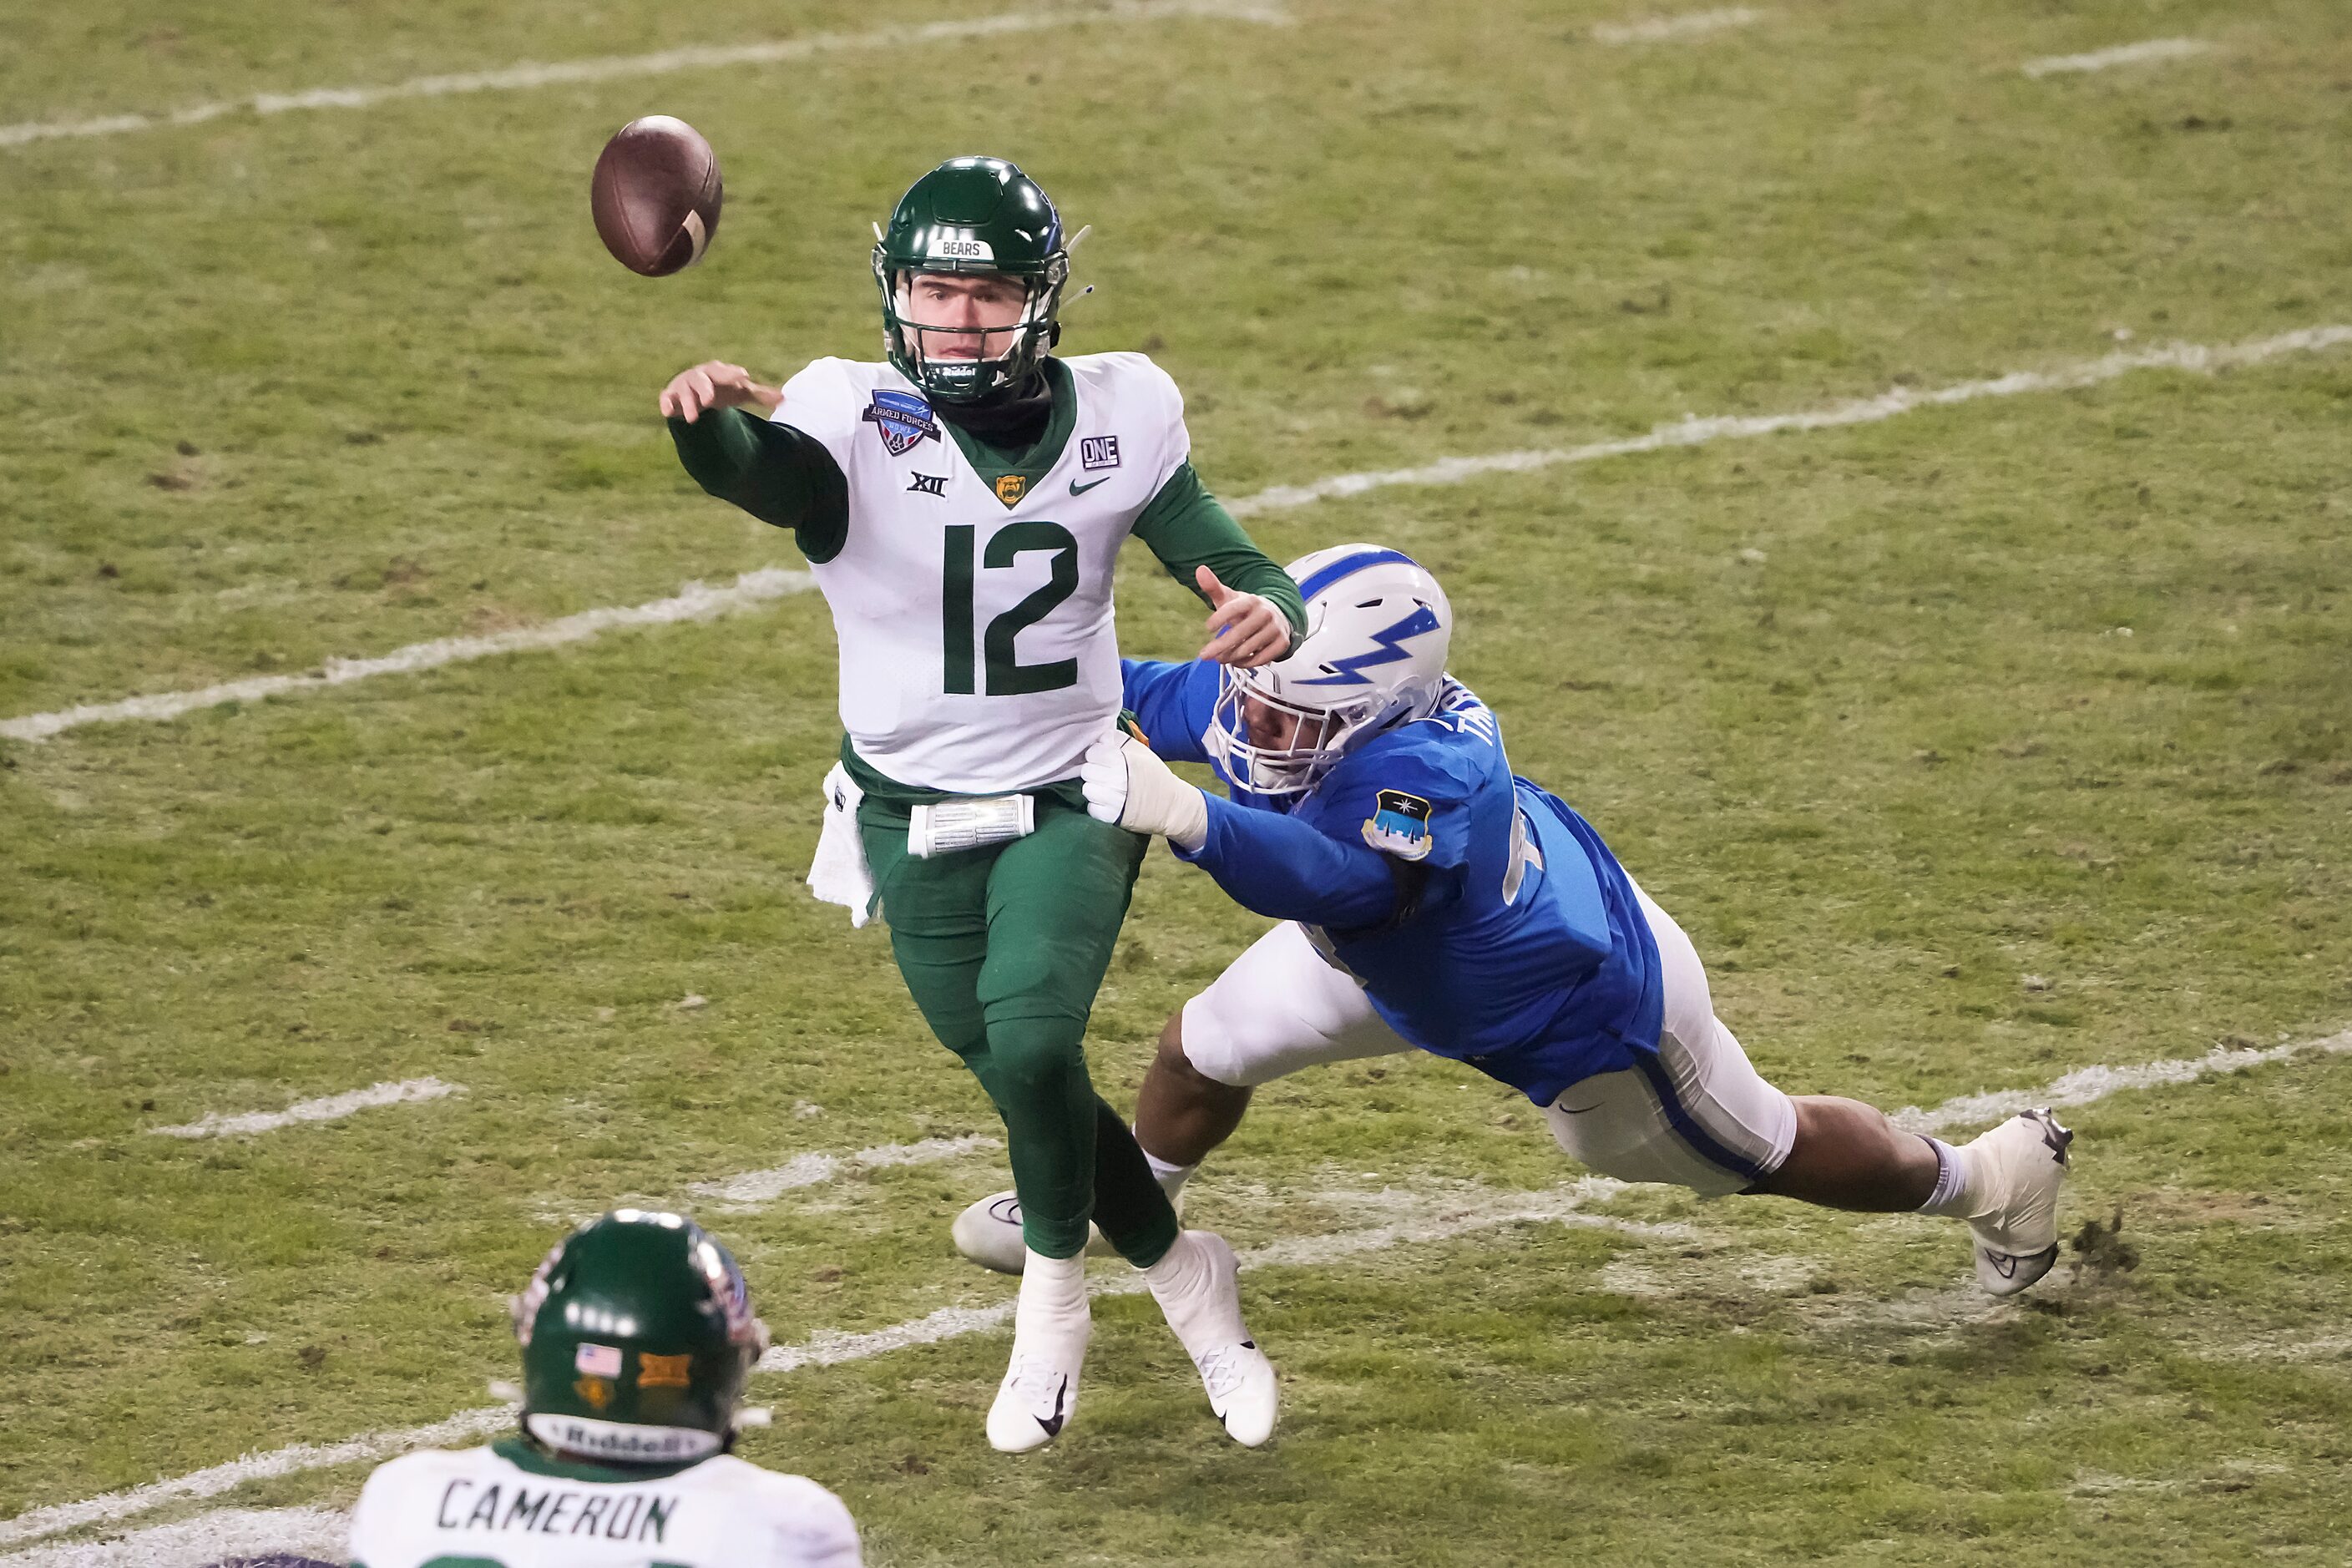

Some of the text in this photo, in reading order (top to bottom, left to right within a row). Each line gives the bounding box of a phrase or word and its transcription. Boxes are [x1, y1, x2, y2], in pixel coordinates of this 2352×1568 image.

[943, 241, 980, 256] BEARS
[871, 406, 933, 432] ARMED FORCES
[1083, 437, 1118, 462] ONE
[906, 470, 948, 498] XII
[943, 521, 1080, 696] 12
[436, 1477, 680, 1544] CAMERON
